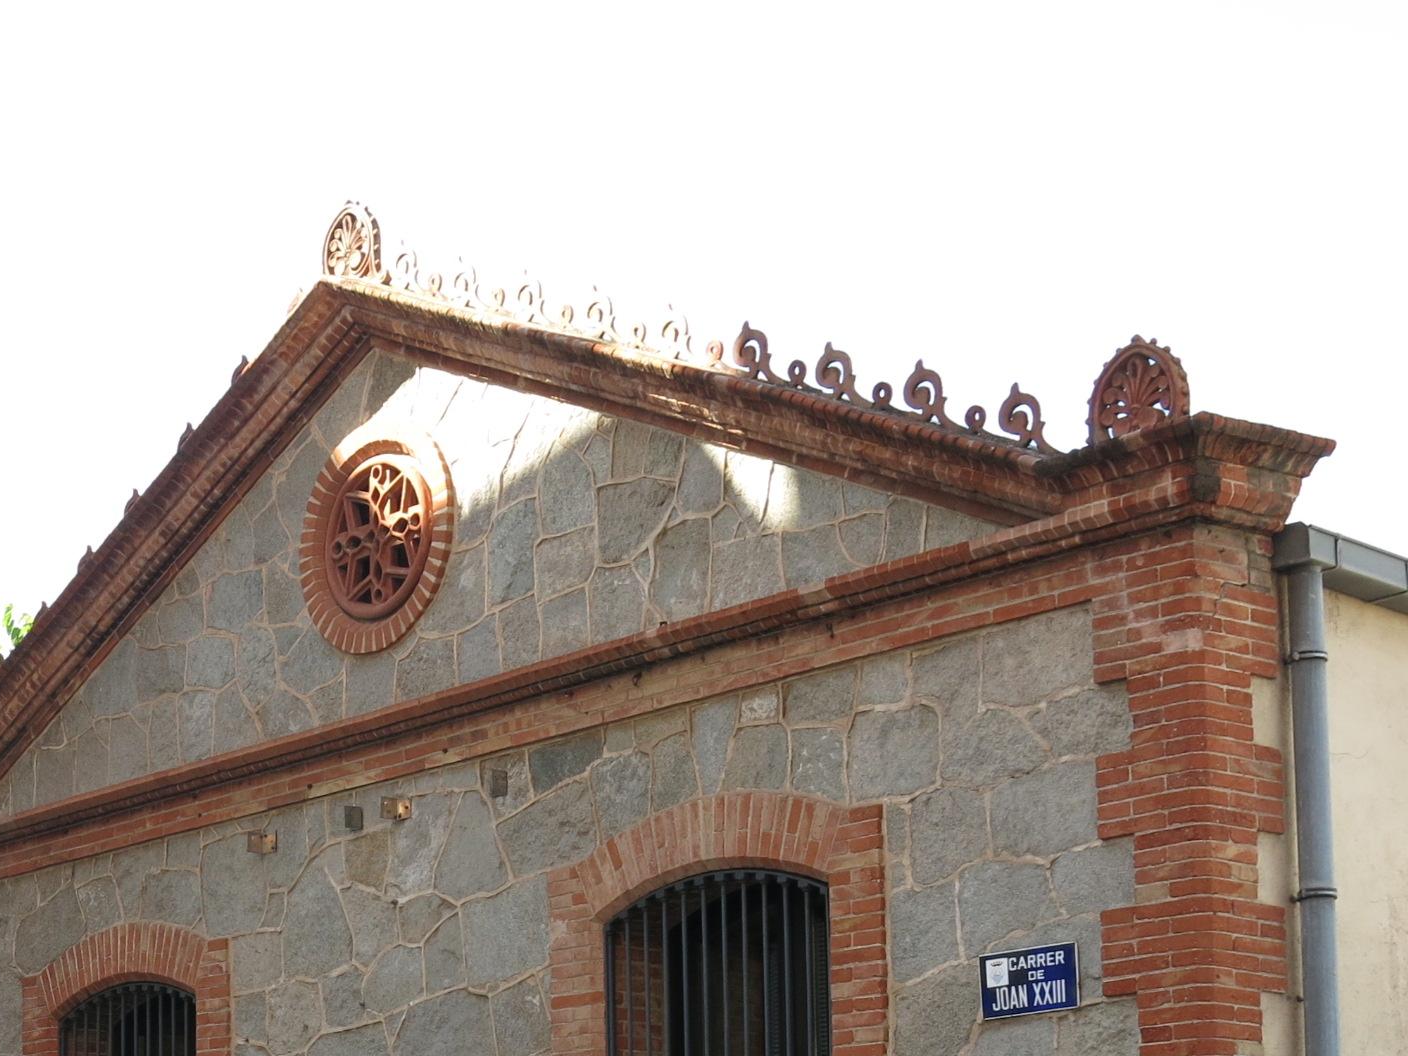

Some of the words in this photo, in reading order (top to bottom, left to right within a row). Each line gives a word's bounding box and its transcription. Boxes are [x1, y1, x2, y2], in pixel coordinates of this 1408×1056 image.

[1008, 950, 1065, 971] CARRER
[1027, 969, 1045, 981] DE
[992, 984, 1029, 1011] JOAN
[1033, 979, 1066, 1006] XXIII
